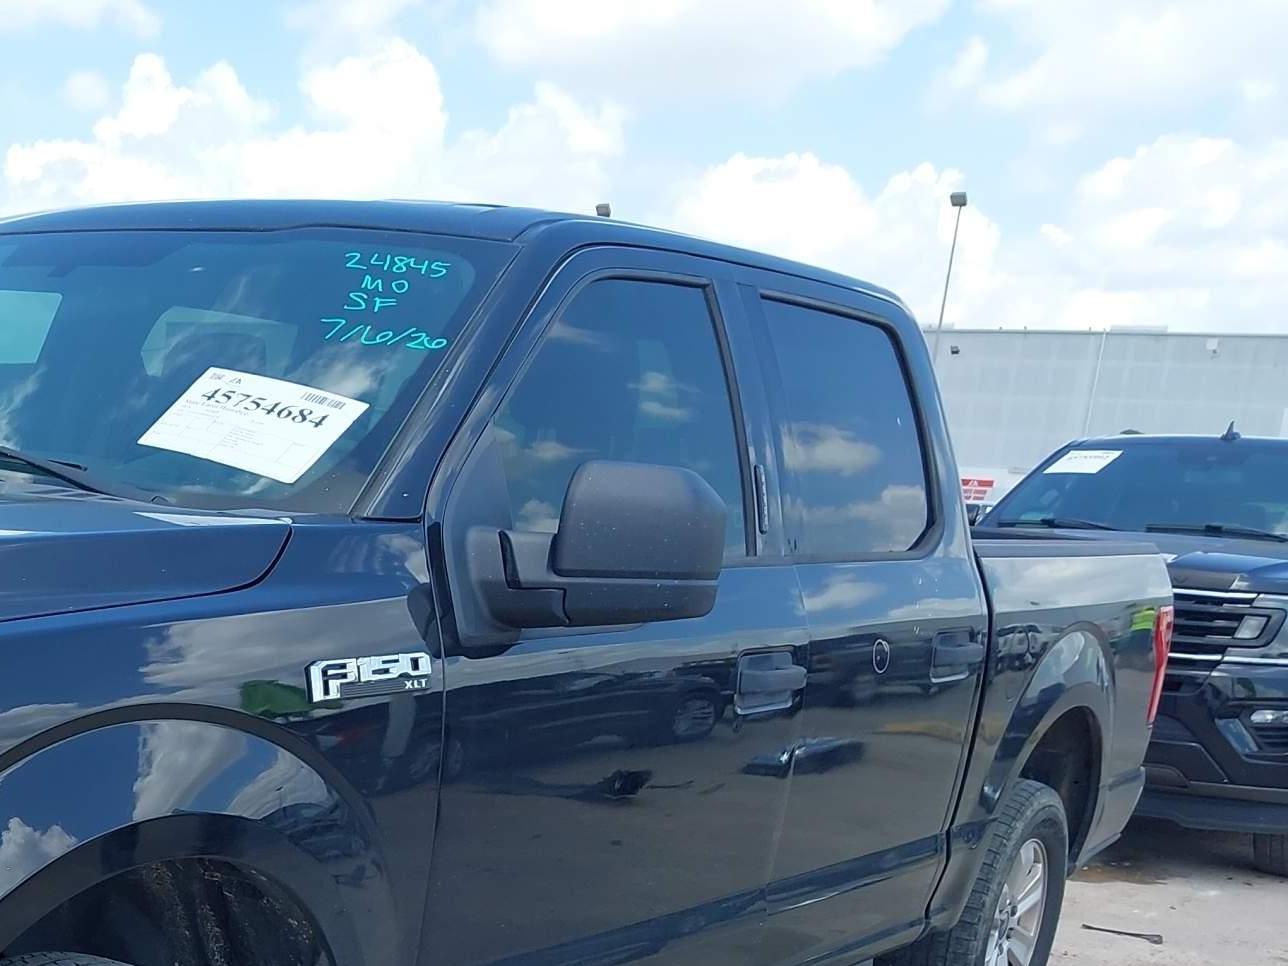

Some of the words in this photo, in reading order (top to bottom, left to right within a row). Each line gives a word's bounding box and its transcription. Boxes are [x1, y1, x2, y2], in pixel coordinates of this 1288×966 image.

[344, 252, 452, 278] 24845
[343, 292, 398, 312] SF
[201, 386, 331, 429] 45754684
[404, 678, 428, 689] XLT
